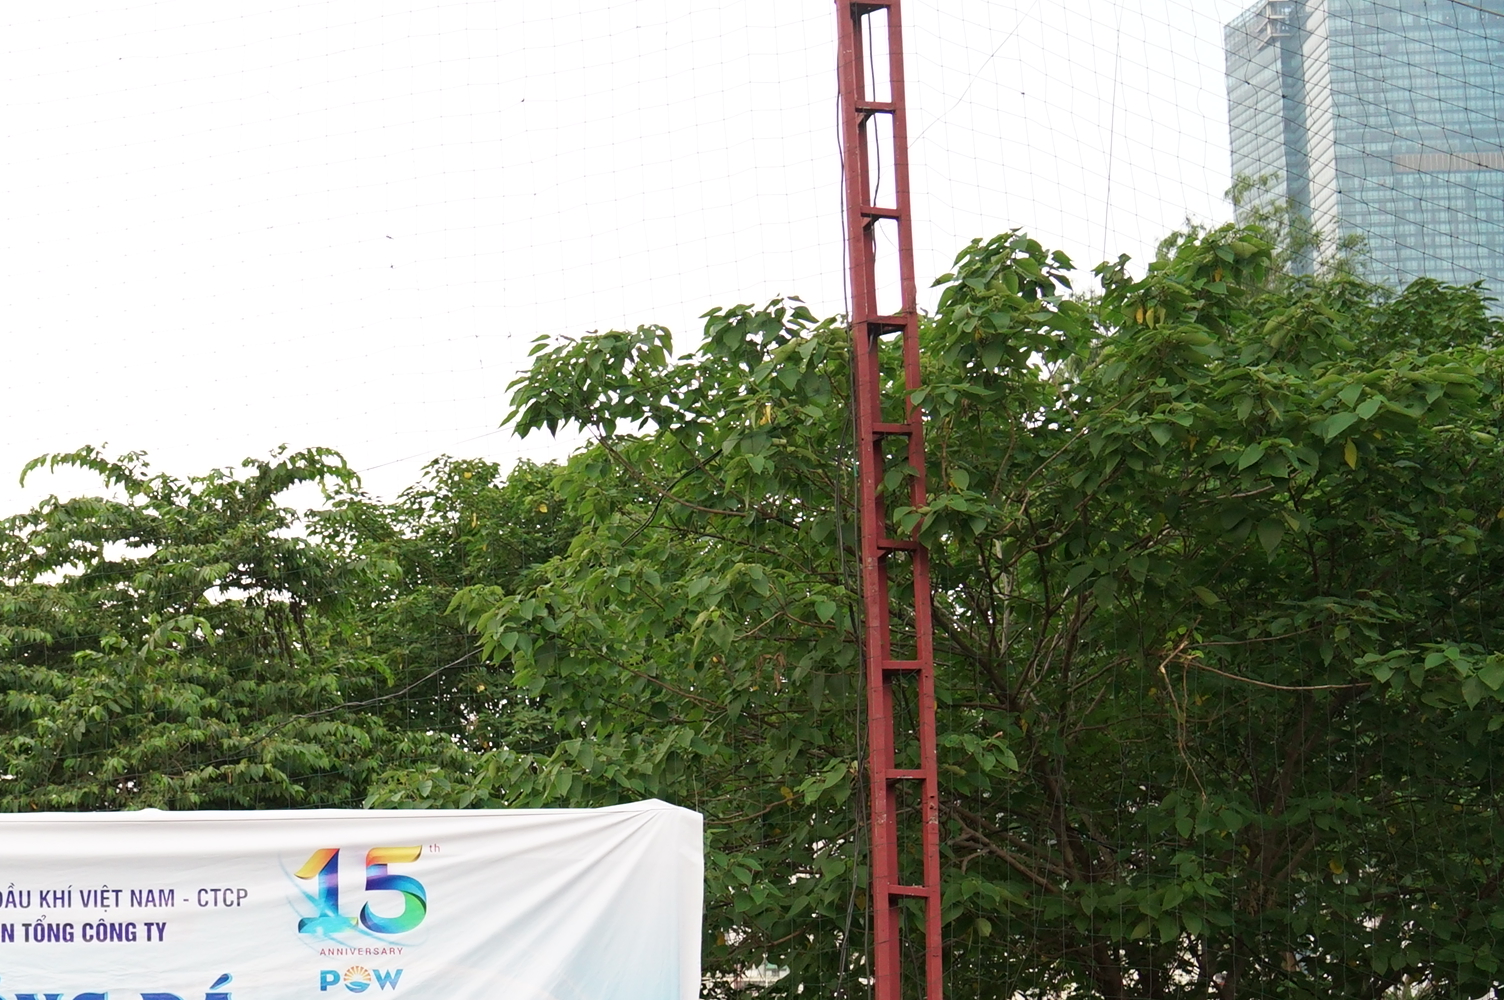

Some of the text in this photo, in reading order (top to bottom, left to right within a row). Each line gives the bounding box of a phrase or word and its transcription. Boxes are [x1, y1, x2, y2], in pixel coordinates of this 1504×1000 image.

[39, 884, 72, 909] KHÍ
[79, 884, 123, 913] VIỆT
[130, 888, 175, 908] NAM
[197, 887, 248, 908] CTCP
[294, 844, 427, 934] 15
[22, 914, 75, 943] TỔNG
[81, 918, 137, 943] CÔNG
[144, 922, 167, 942] TY
[319, 947, 404, 956] ANNIVERSARY
